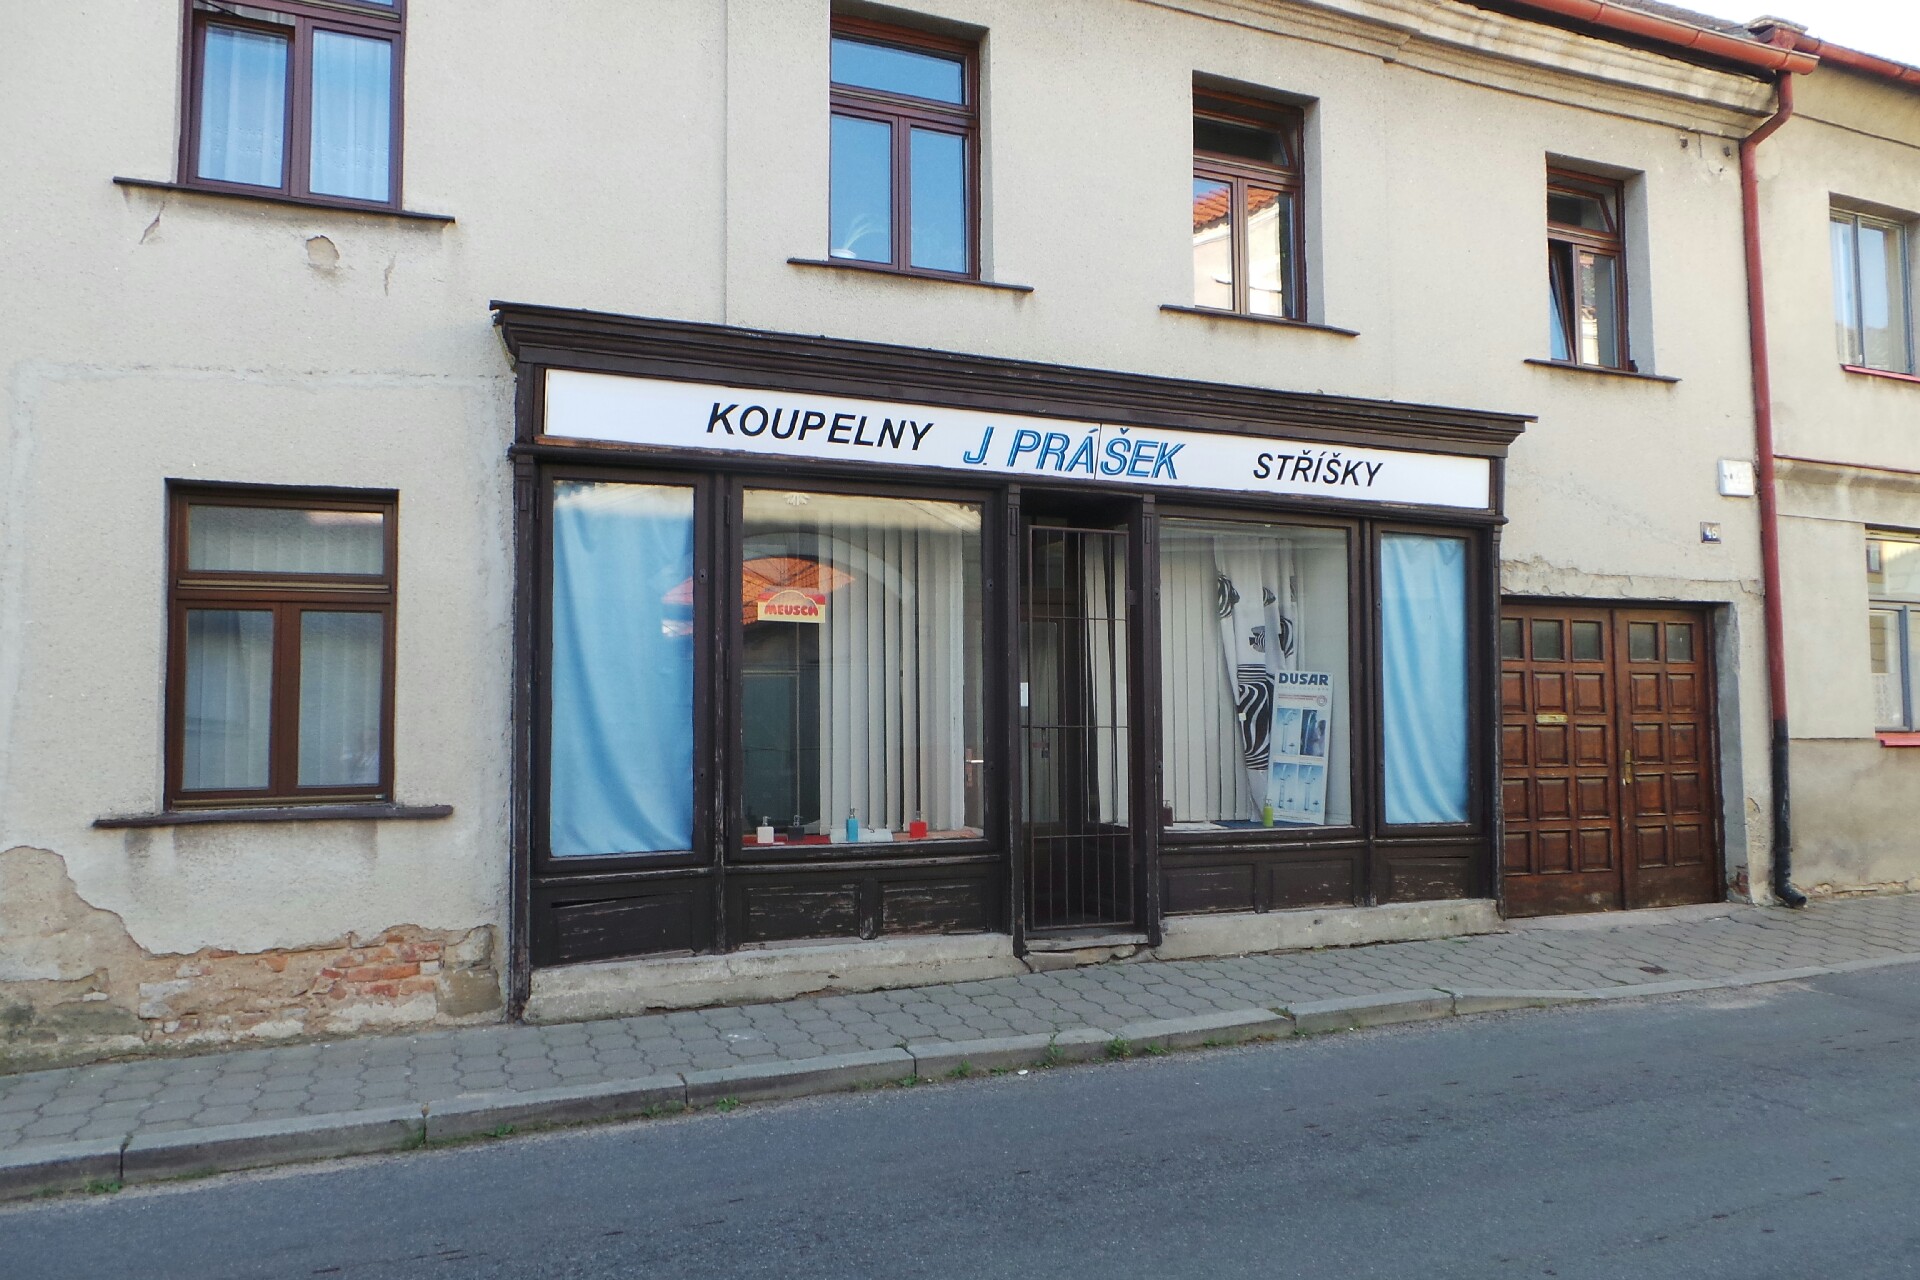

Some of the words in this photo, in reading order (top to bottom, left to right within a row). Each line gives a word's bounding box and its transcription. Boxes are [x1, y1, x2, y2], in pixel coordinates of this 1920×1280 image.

[706, 402, 935, 451] KOUPELNY
[1006, 427, 1186, 480] PRÁŠEK
[1253, 449, 1384, 487] STŘÍŠKY
[1706, 527, 1718, 539] 46
[1279, 672, 1329, 686] DUSAR
